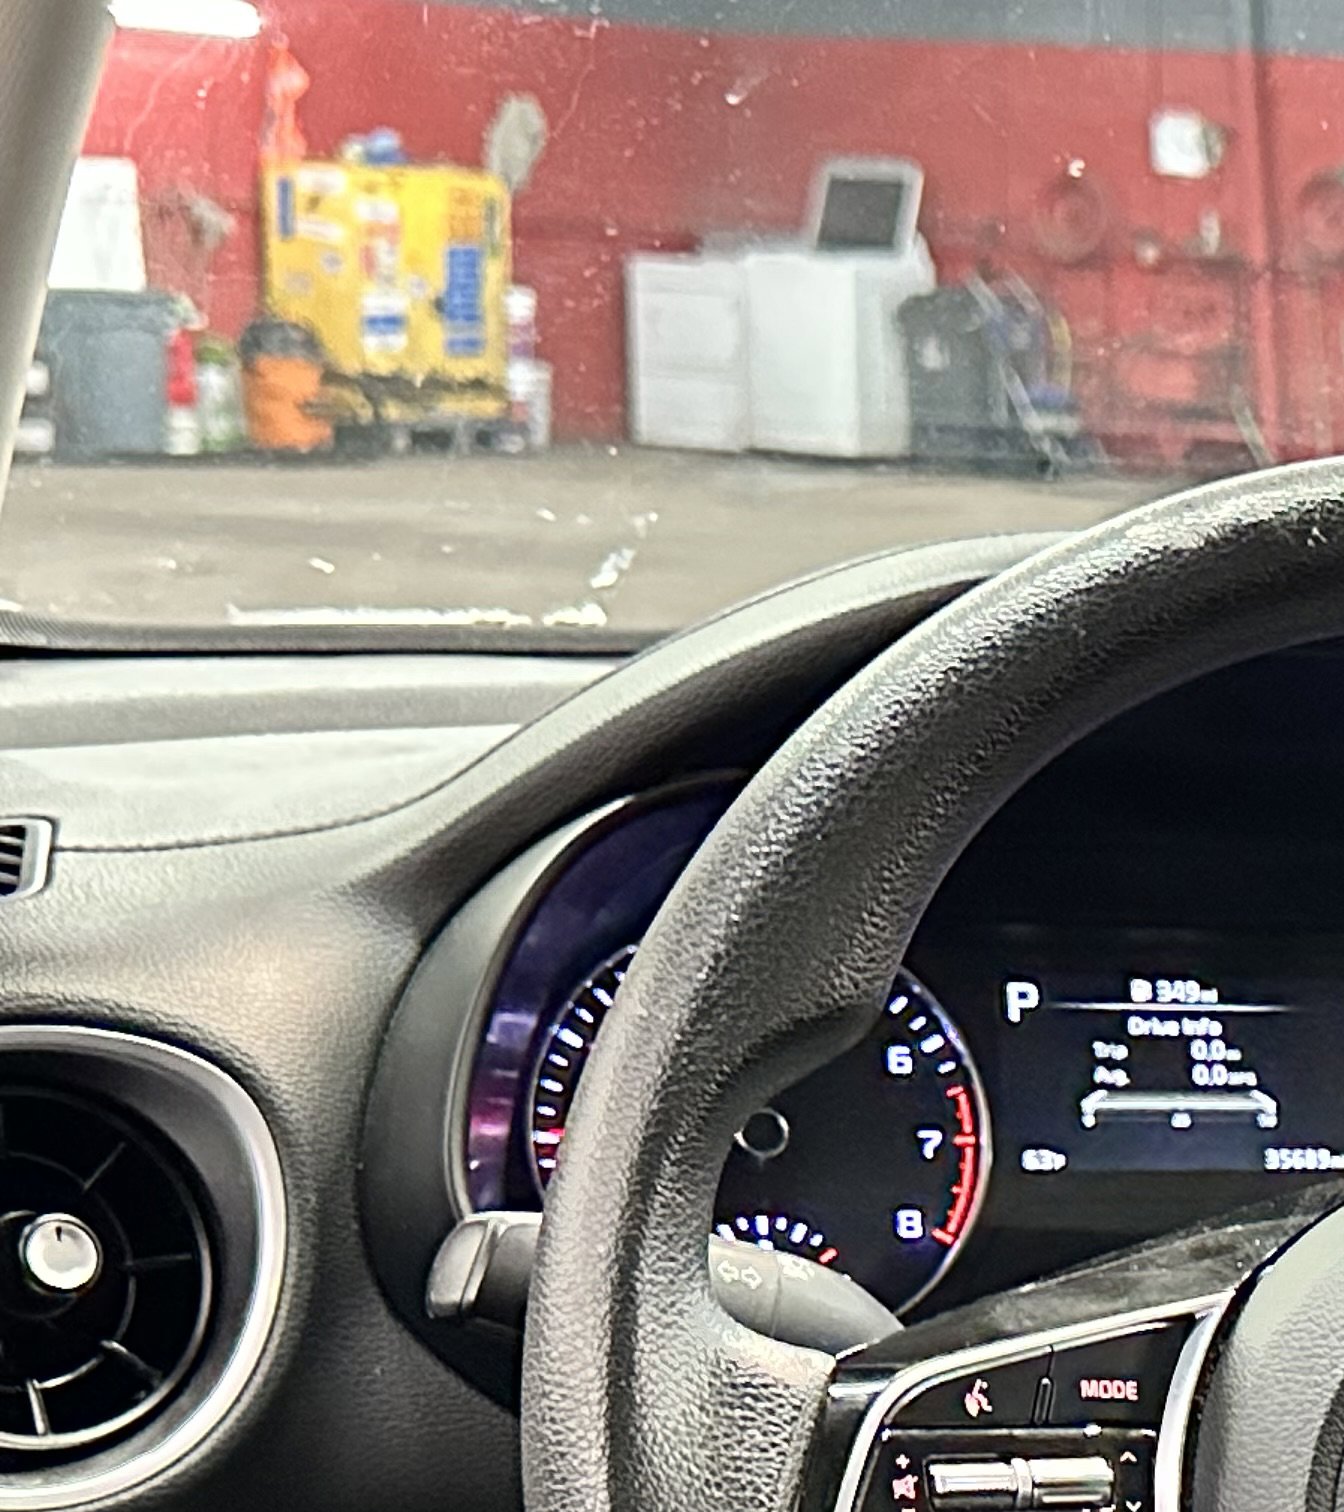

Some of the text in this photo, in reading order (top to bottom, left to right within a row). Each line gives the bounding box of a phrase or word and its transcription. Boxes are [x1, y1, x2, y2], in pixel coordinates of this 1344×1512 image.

[1006, 981, 1040, 1023] P
[887, 1046, 912, 1075] 6
[917, 1129, 944, 1160] 7
[896, 1210, 923, 1239] 8
[1080, 1379, 1139, 1401] MODE
